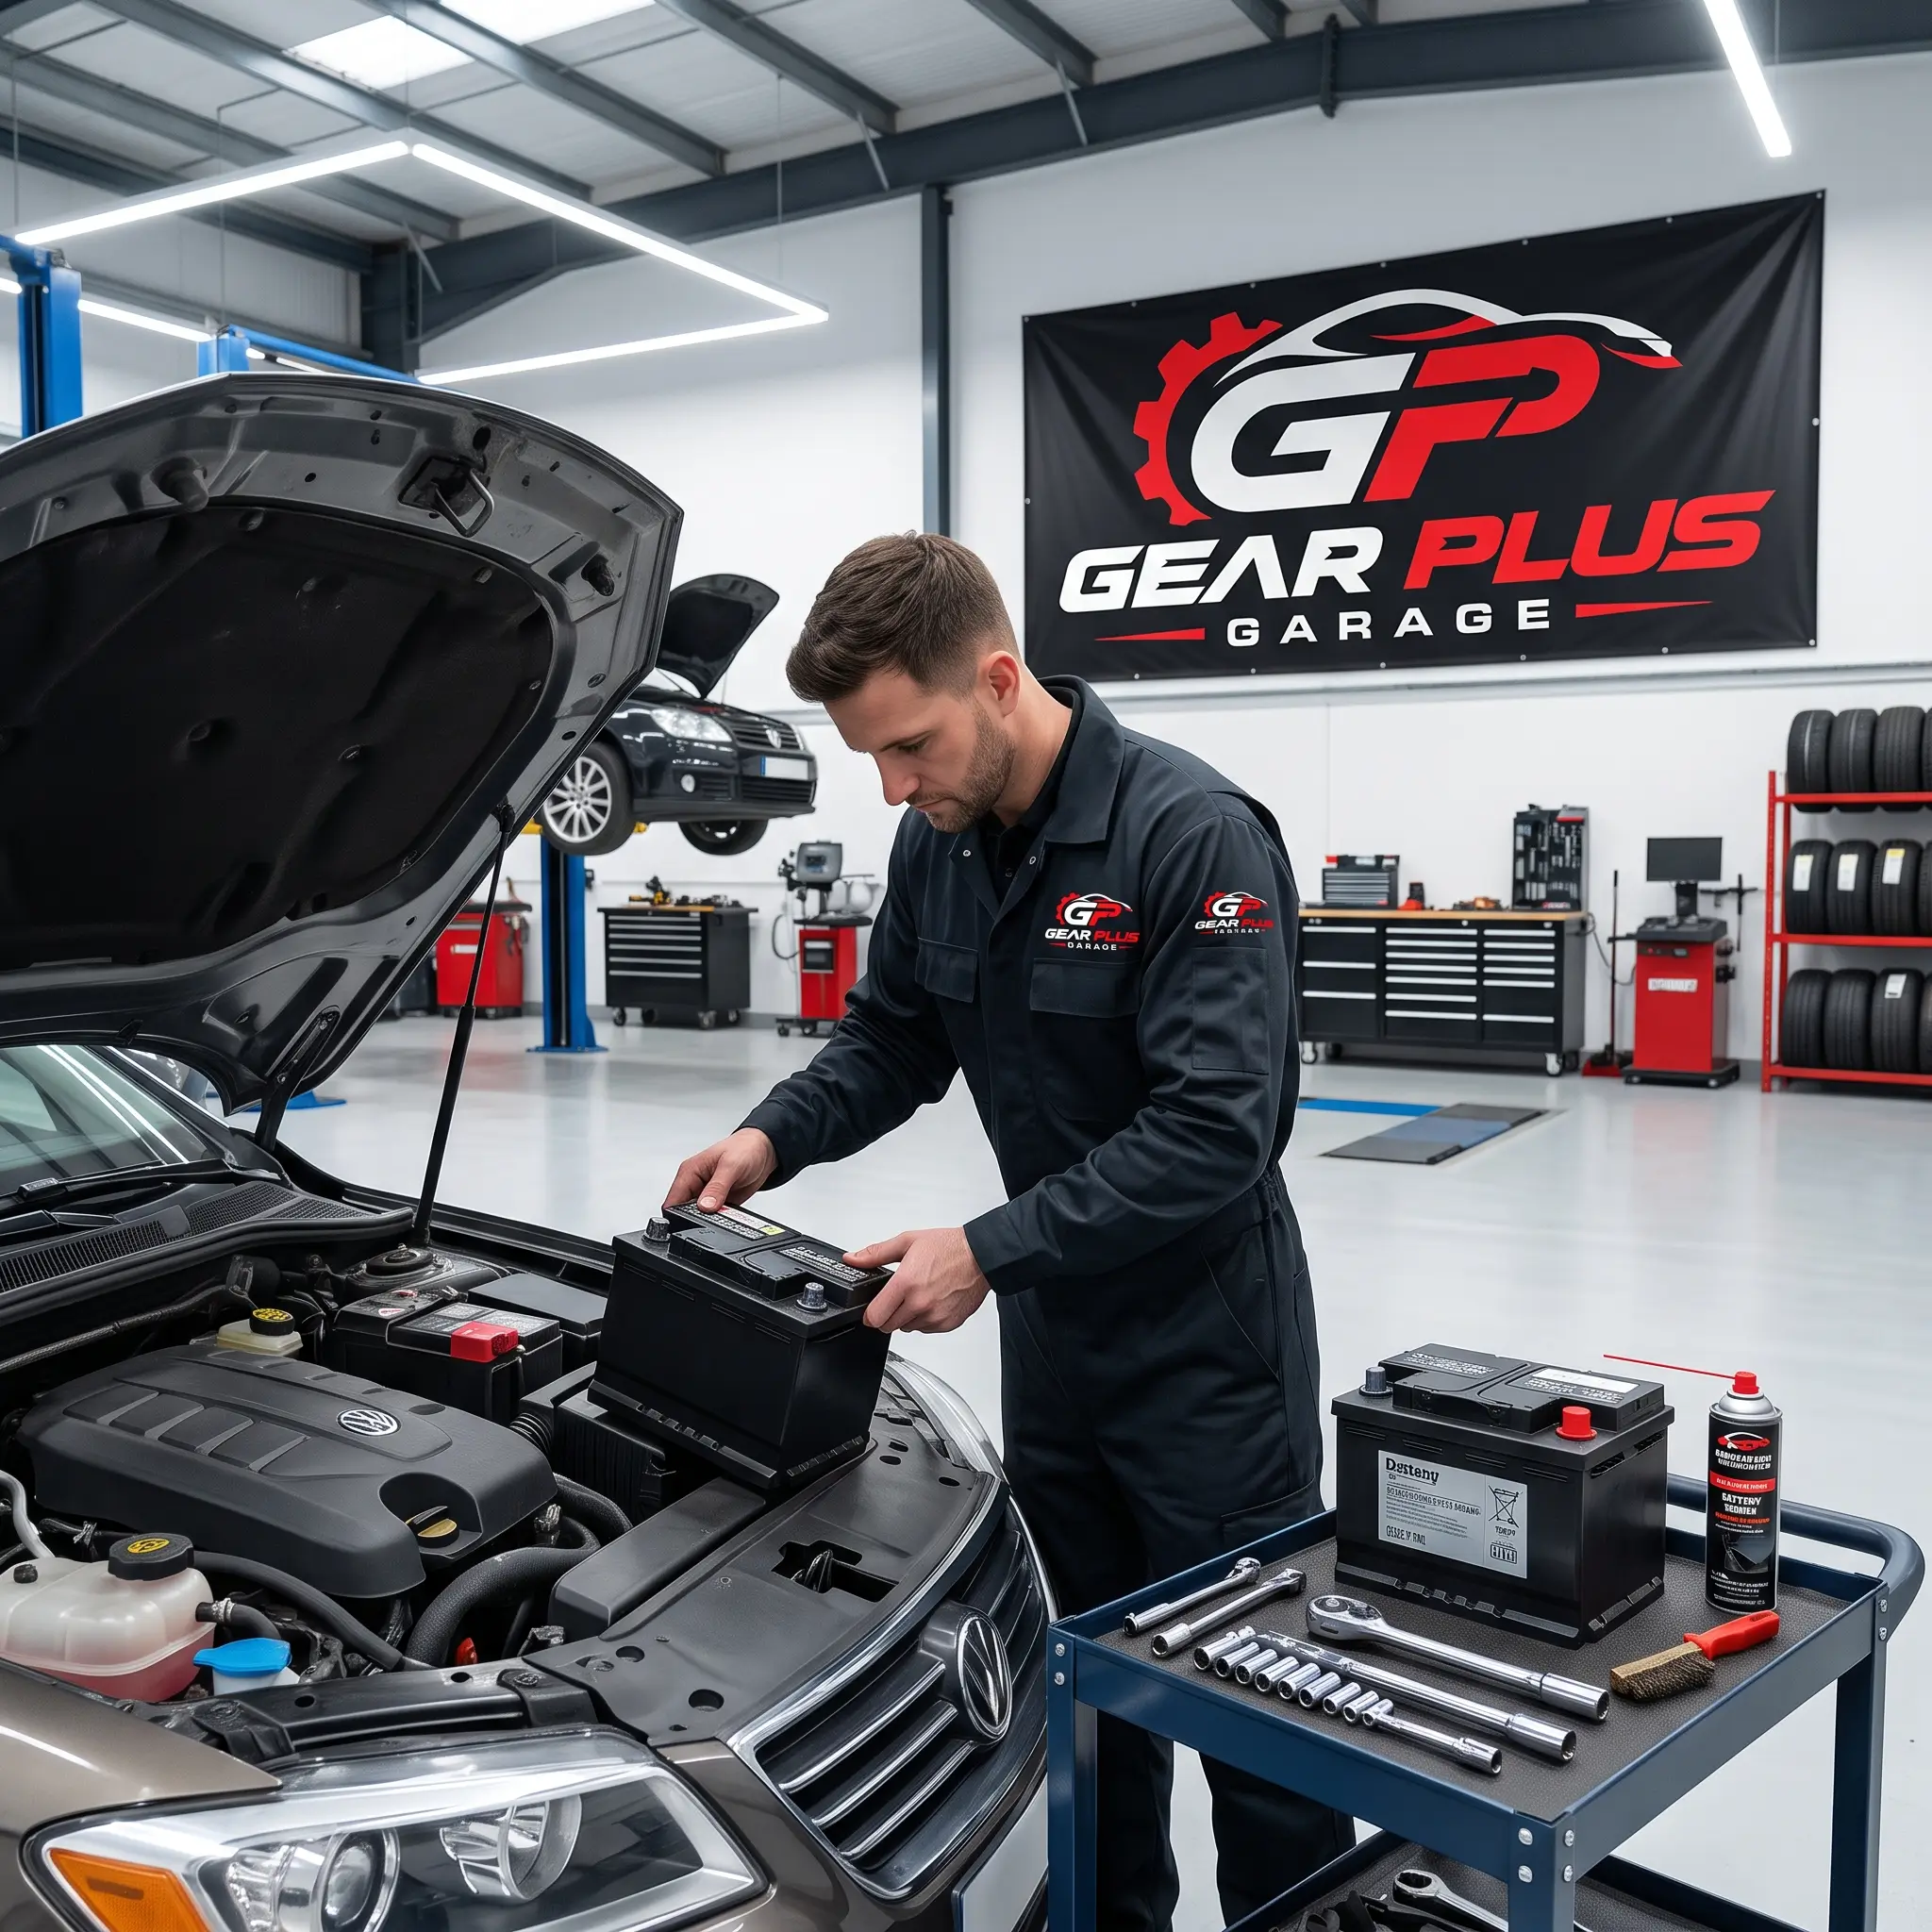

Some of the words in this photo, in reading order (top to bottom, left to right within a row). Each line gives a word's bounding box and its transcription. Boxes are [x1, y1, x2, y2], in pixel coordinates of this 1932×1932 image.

[1191, 334, 1601, 513] GP
[1058, 525, 1385, 613] GEAR
[1403, 490, 1777, 590] PLUS
[1226, 598, 1551, 647] GARAGE
[1044, 928, 1091, 941] GEAR
[1093, 930, 1141, 942] PLUS
[1194, 919, 1240, 929] GEAR
